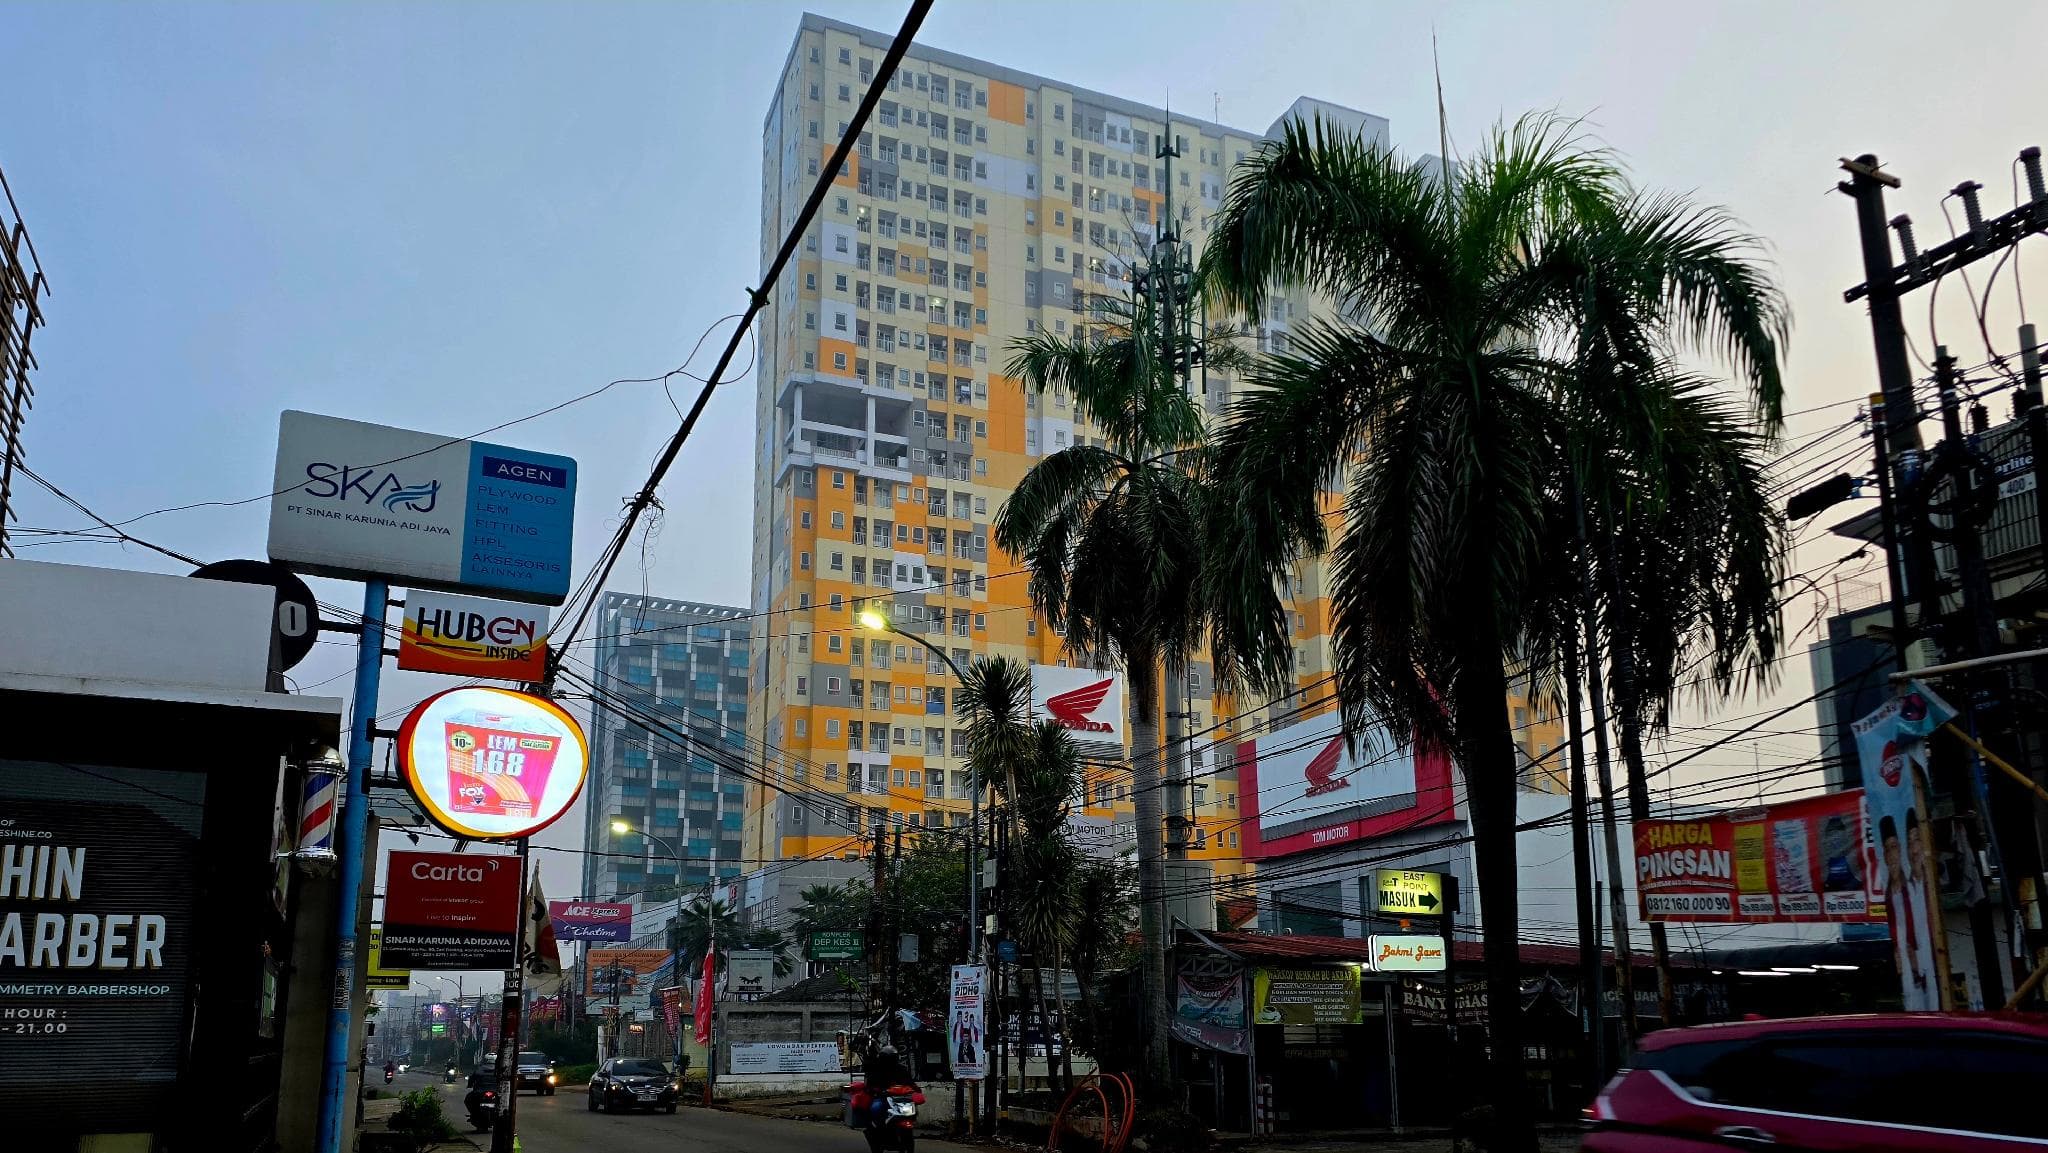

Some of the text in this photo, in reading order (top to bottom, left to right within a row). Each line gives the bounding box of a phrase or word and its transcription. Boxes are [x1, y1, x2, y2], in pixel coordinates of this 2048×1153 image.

[496, 462, 552, 482] AGEN
[479, 485, 557, 506] PLYWOOD
[476, 503, 509, 515] LEM
[287, 505, 451, 536] PT SINAR KARUNIA ADI JAYA
[475, 519, 538, 536] FITTING
[472, 536, 506, 550] HPL
[471, 553, 561, 572] AKSESORIS
[471, 565, 533, 580] LAINNYA
[485, 646, 532, 662] INSIDE
[473, 749, 525, 776] 168
[1078, 825, 1106, 836] MOTOR
[1327, 826, 1349, 841] MOTOR
[1648, 823, 1713, 849] HARGA
[411, 861, 482, 881] Carta
[1638, 849, 1731, 881] PINGSAN
[1403, 872, 1426, 881] EAST
[1403, 882, 1429, 891] POINT
[1380, 891, 1416, 907] MASUK
[563, 904, 590, 916] ACE
[574, 926, 617, 937] Chatime
[385, 936, 416, 945] SINAR
[417, 936, 462, 945] KARUNIA
[463, 937, 511, 946] ADIDJAYA
[1379, 945, 1442, 962] Bakmi Jawa
[67, 985, 170, 996] BARBERSHOP
[15, 1023, 68, 1034] 21.00
